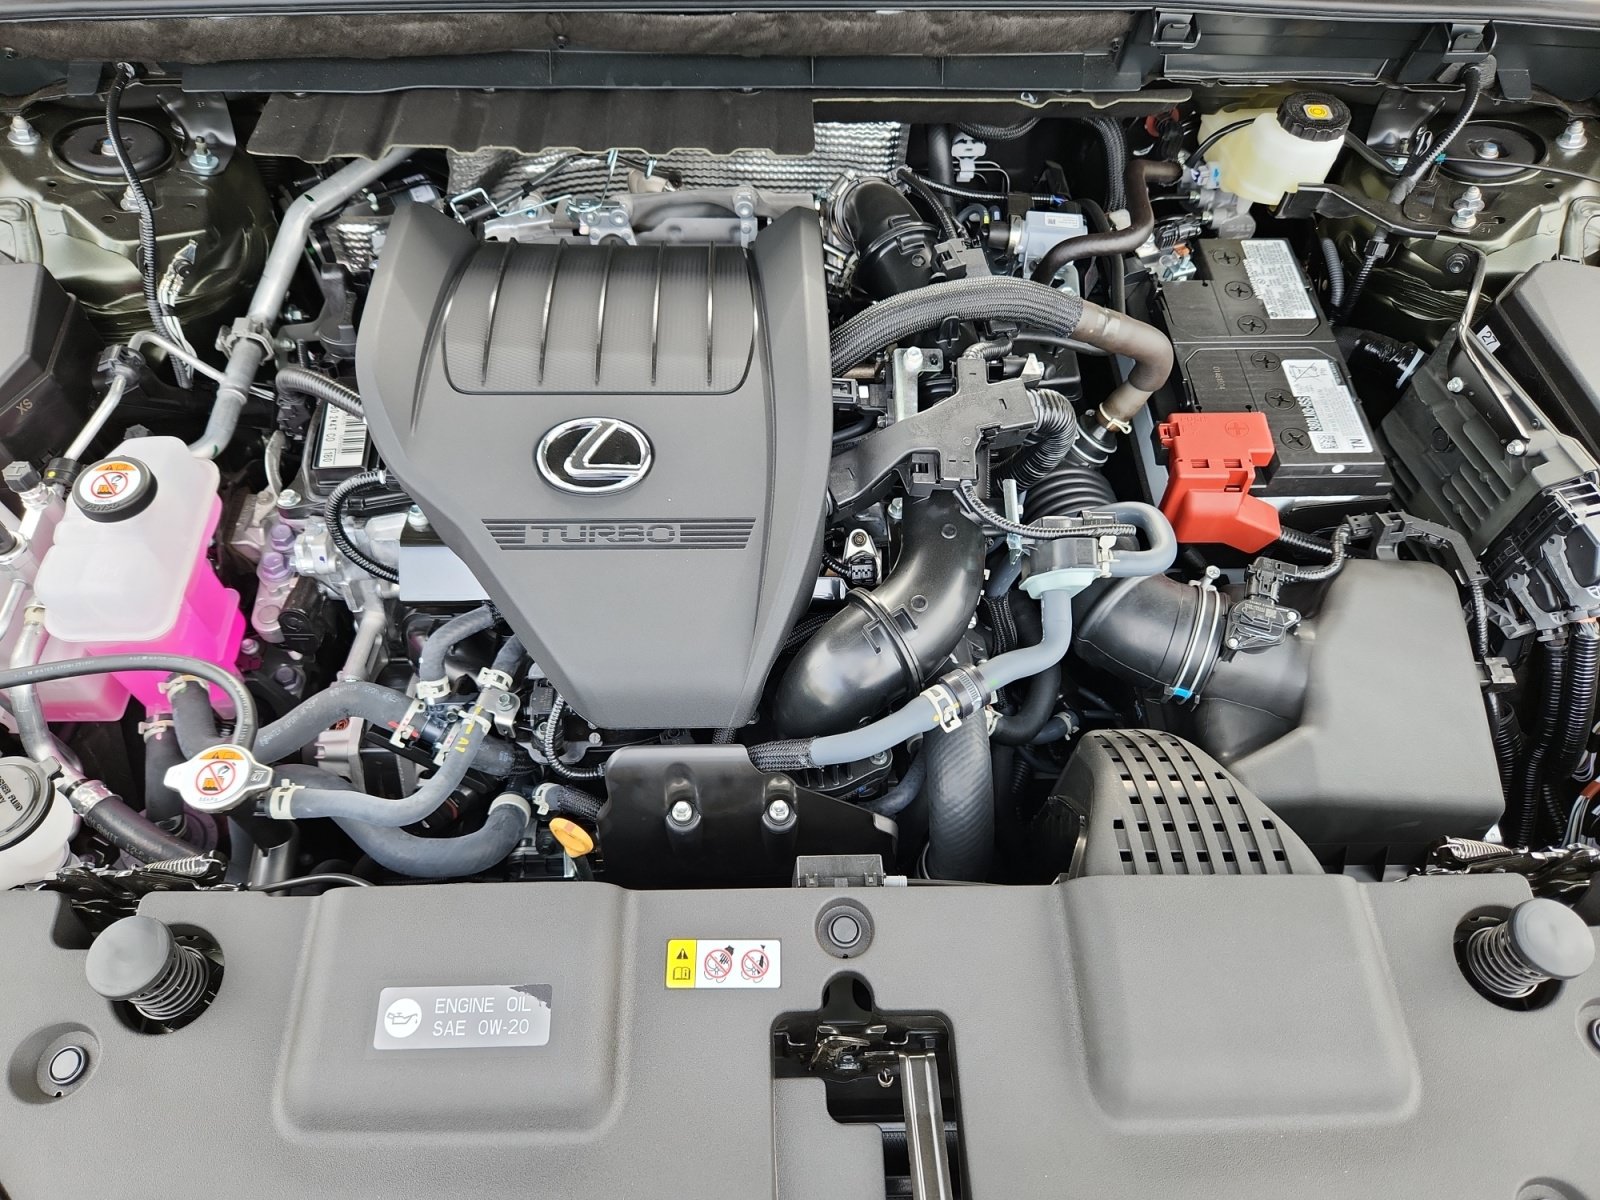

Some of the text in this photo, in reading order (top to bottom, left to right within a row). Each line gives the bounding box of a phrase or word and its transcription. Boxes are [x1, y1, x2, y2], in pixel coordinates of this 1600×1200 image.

[1482, 331, 1498, 346] 27
[530, 524, 676, 544] TURBO
[434, 996, 532, 1014] ENGINE OIL
[432, 1018, 530, 1037] SAE 0W-20
